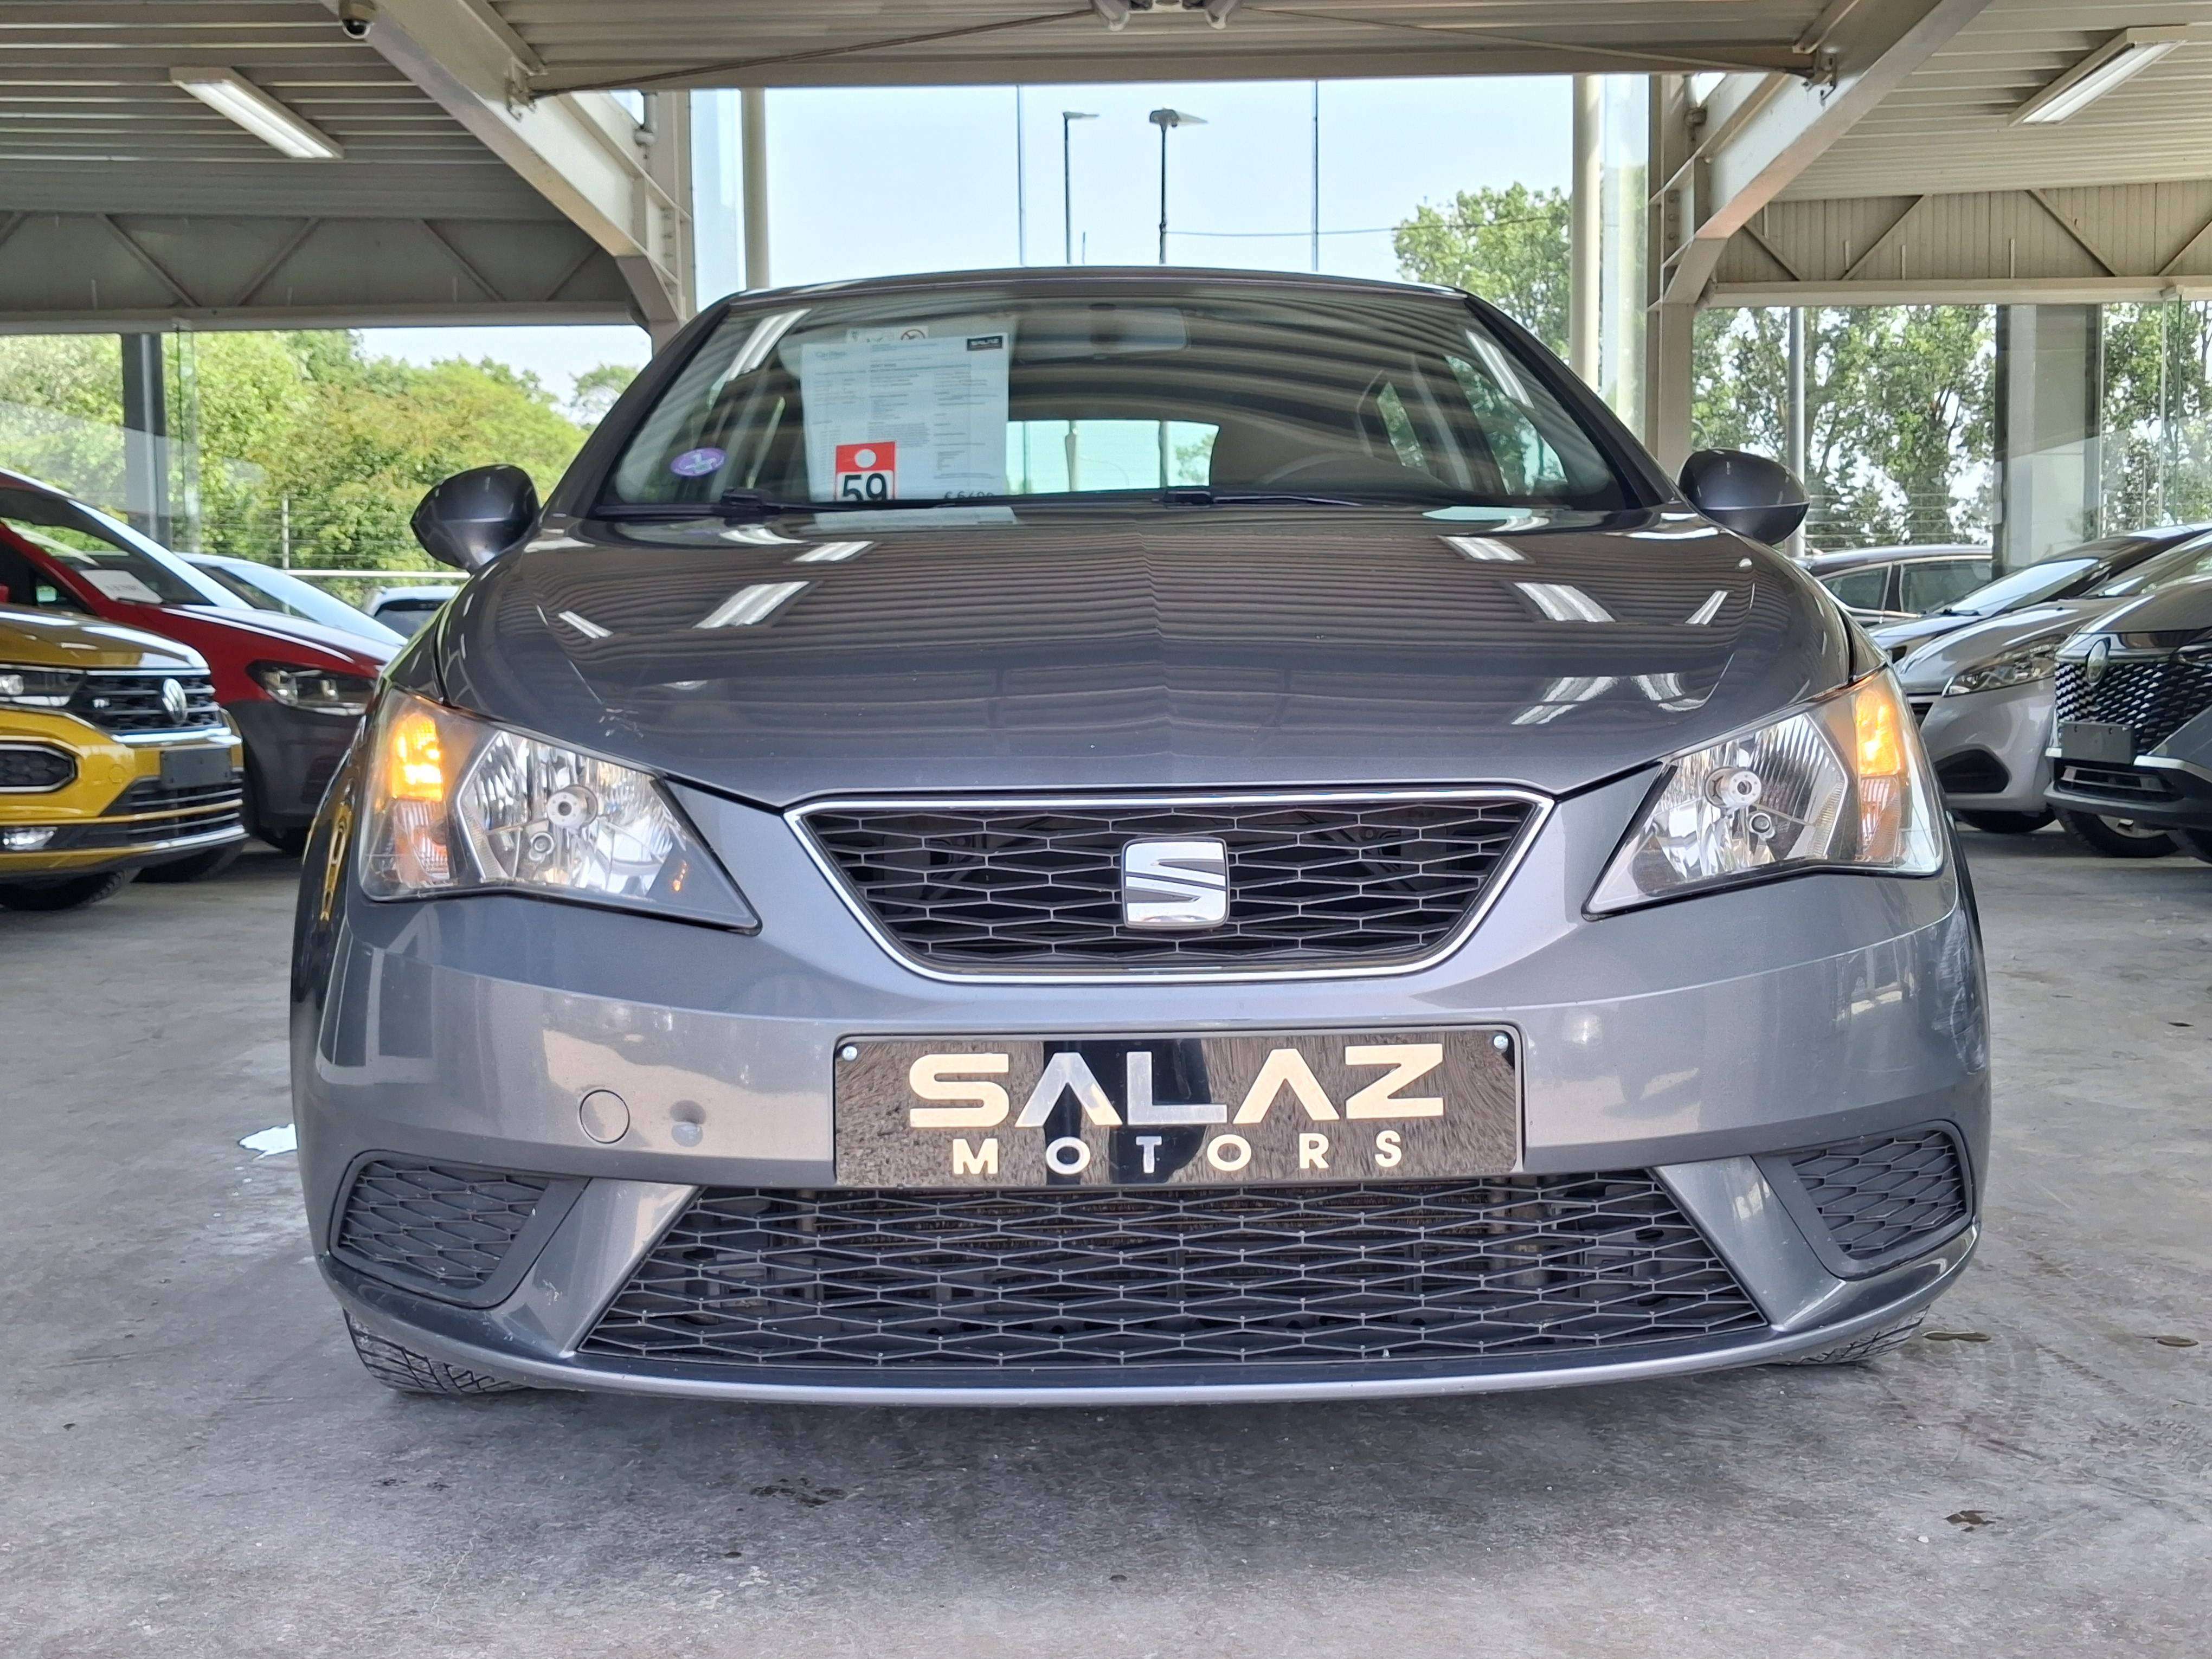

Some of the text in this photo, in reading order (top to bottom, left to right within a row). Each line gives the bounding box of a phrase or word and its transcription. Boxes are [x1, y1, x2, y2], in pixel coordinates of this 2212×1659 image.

[843, 473, 888, 501] 59
[909, 1043, 1444, 1128] SALAZ
[952, 1129, 1403, 1175] MOTORS
